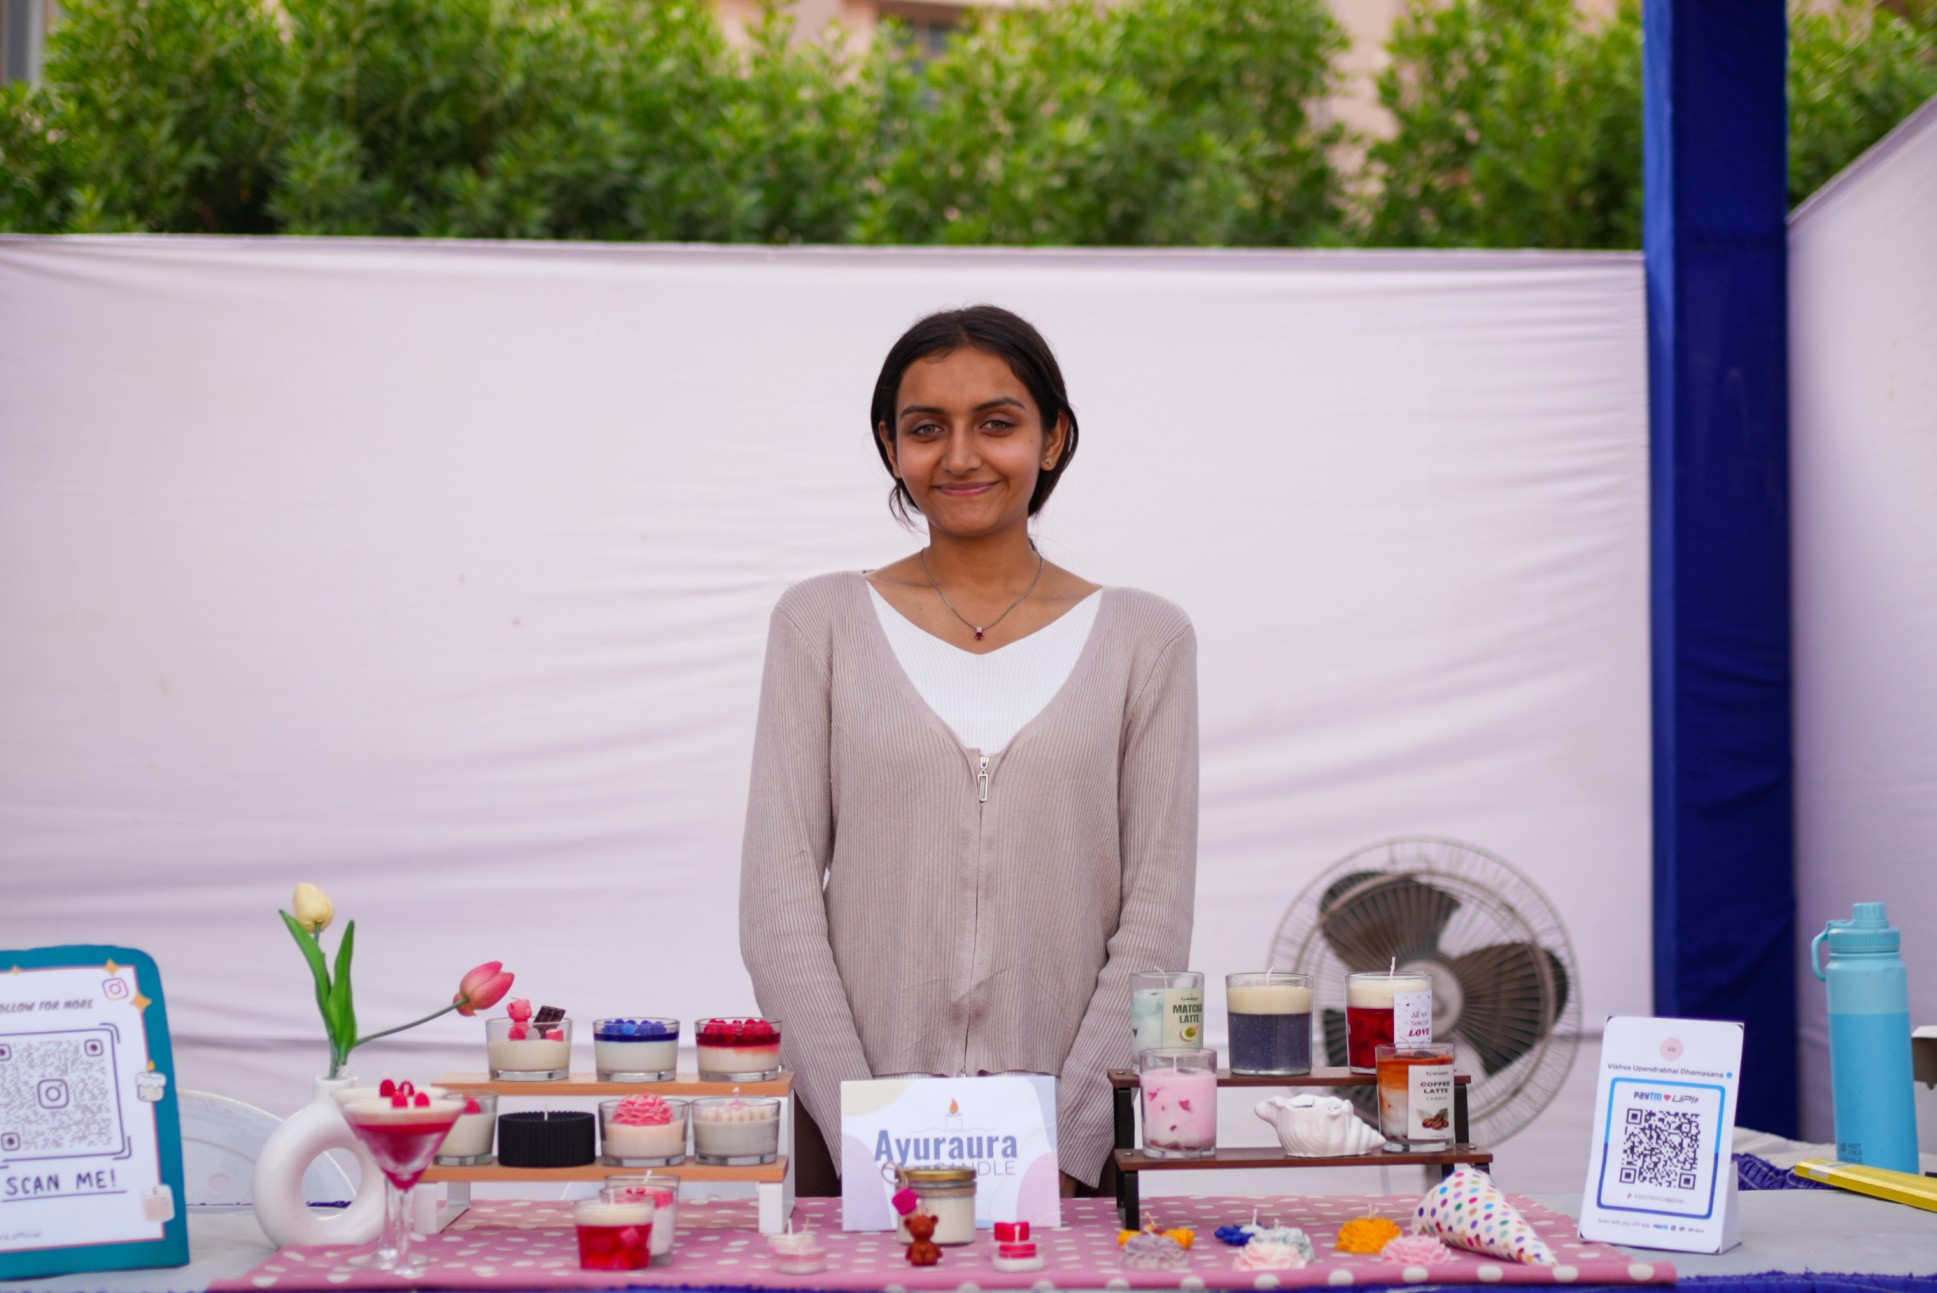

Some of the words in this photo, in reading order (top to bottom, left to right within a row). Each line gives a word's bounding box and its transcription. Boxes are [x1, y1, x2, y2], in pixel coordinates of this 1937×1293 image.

[0, 1002, 35, 1013] OLLOW
[39, 1001, 60, 1010] FOR
[63, 999, 94, 1010] MORE
[1179, 1014, 1200, 1024] LATTE
[1408, 1028, 1430, 1037] LOVE
[1607, 1063, 1632, 1071] Vishva
[1680, 1068, 1724, 1078] Dhamasana
[874, 1129, 1018, 1167] Ayuraura
[934, 1160, 1016, 1176] NDLE
[5, 1173, 60, 1196] SCAN
[75, 1169, 117, 1190] ME!
